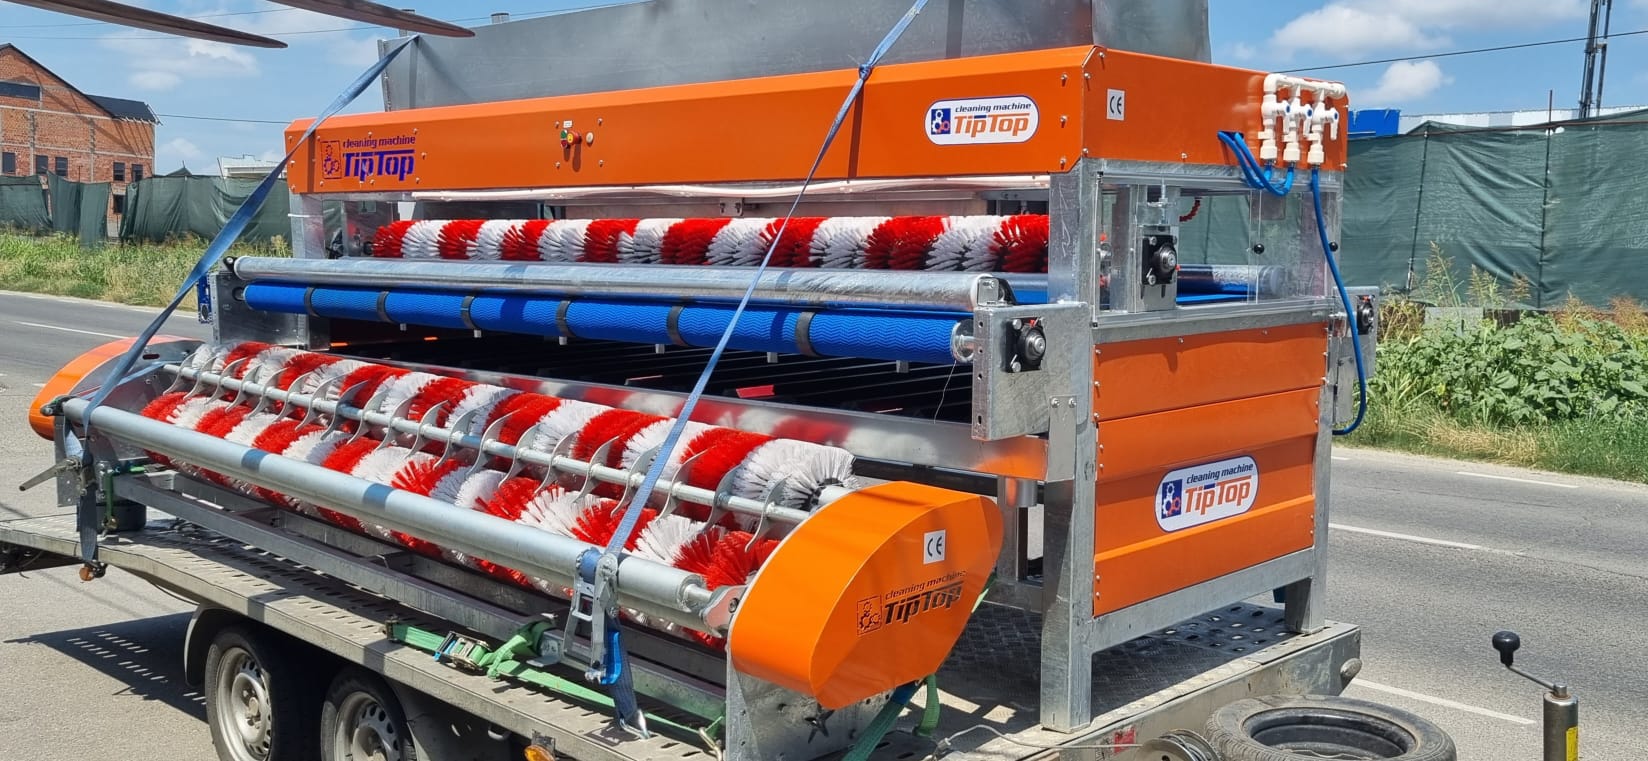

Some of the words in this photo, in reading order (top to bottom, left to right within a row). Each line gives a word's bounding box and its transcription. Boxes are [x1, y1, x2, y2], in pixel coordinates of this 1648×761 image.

[954, 104, 992, 113] cleaning
[993, 101, 1032, 111] machine
[343, 138, 377, 149] cleaning
[378, 135, 416, 147] machine
[1186, 470, 1221, 485] cleaning
[1221, 463, 1254, 477] machine
[885, 581, 925, 601] cleaning
